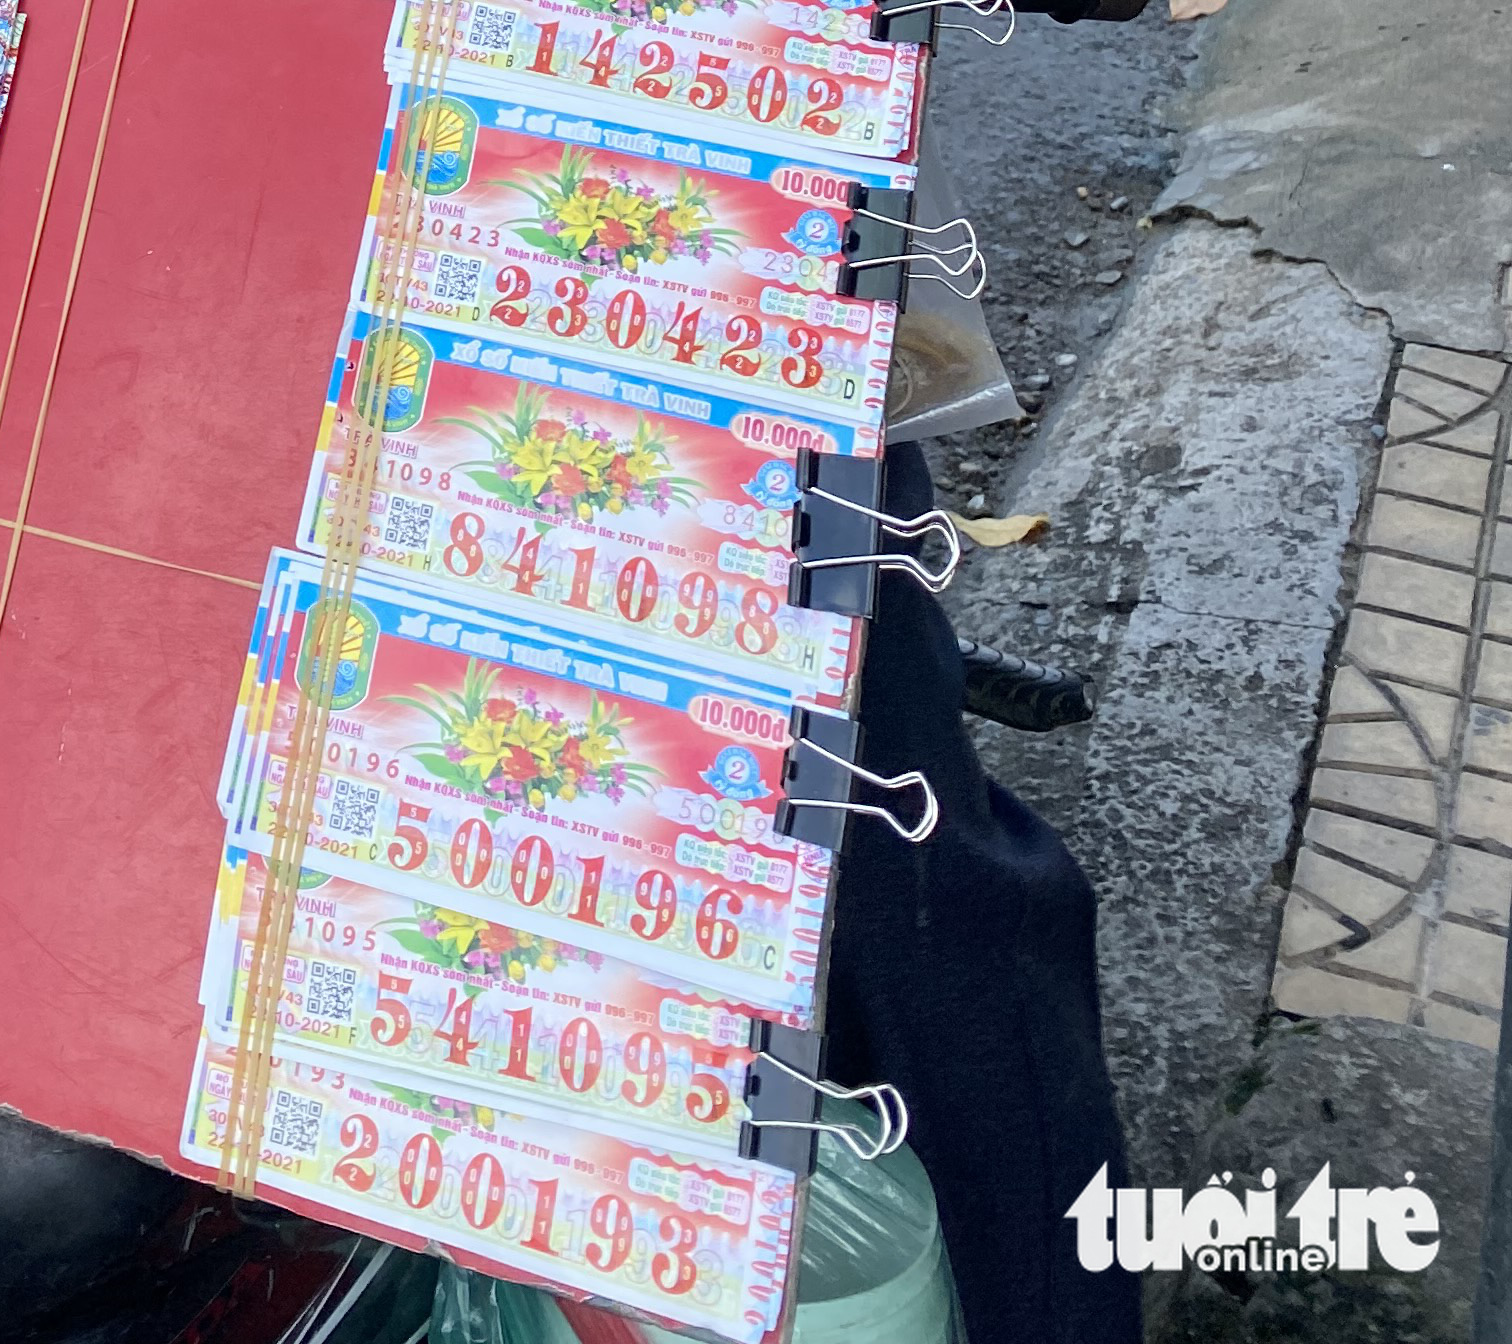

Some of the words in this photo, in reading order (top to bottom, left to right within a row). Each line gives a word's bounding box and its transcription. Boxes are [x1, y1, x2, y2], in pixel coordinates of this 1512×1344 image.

[526, 20, 845, 136] 142502
[661, 140, 701, 165] TRÀ
[704, 150, 752, 173] VINH
[782, 171, 847, 203] 10.000
[428, 200, 466, 219] VINH
[490, 264, 824, 390] 230423
[620, 381, 660, 408] TRÀ
[663, 392, 711, 420] VINH
[380, 438, 418, 457] VINH
[443, 511, 780, 655] 841098
[325, 716, 365, 739] VINH
[728, 759, 746, 779] 2
[387, 799, 742, 961] 500196
[380, 953, 408, 970] Nhận
[410, 959, 440, 976] KQXS
[370, 971, 730, 1124] 541095
[349, 1088, 377, 1107] Nhận
[379, 1097, 409, 1116] KQXS
[332, 1111, 698, 1296] 200193
